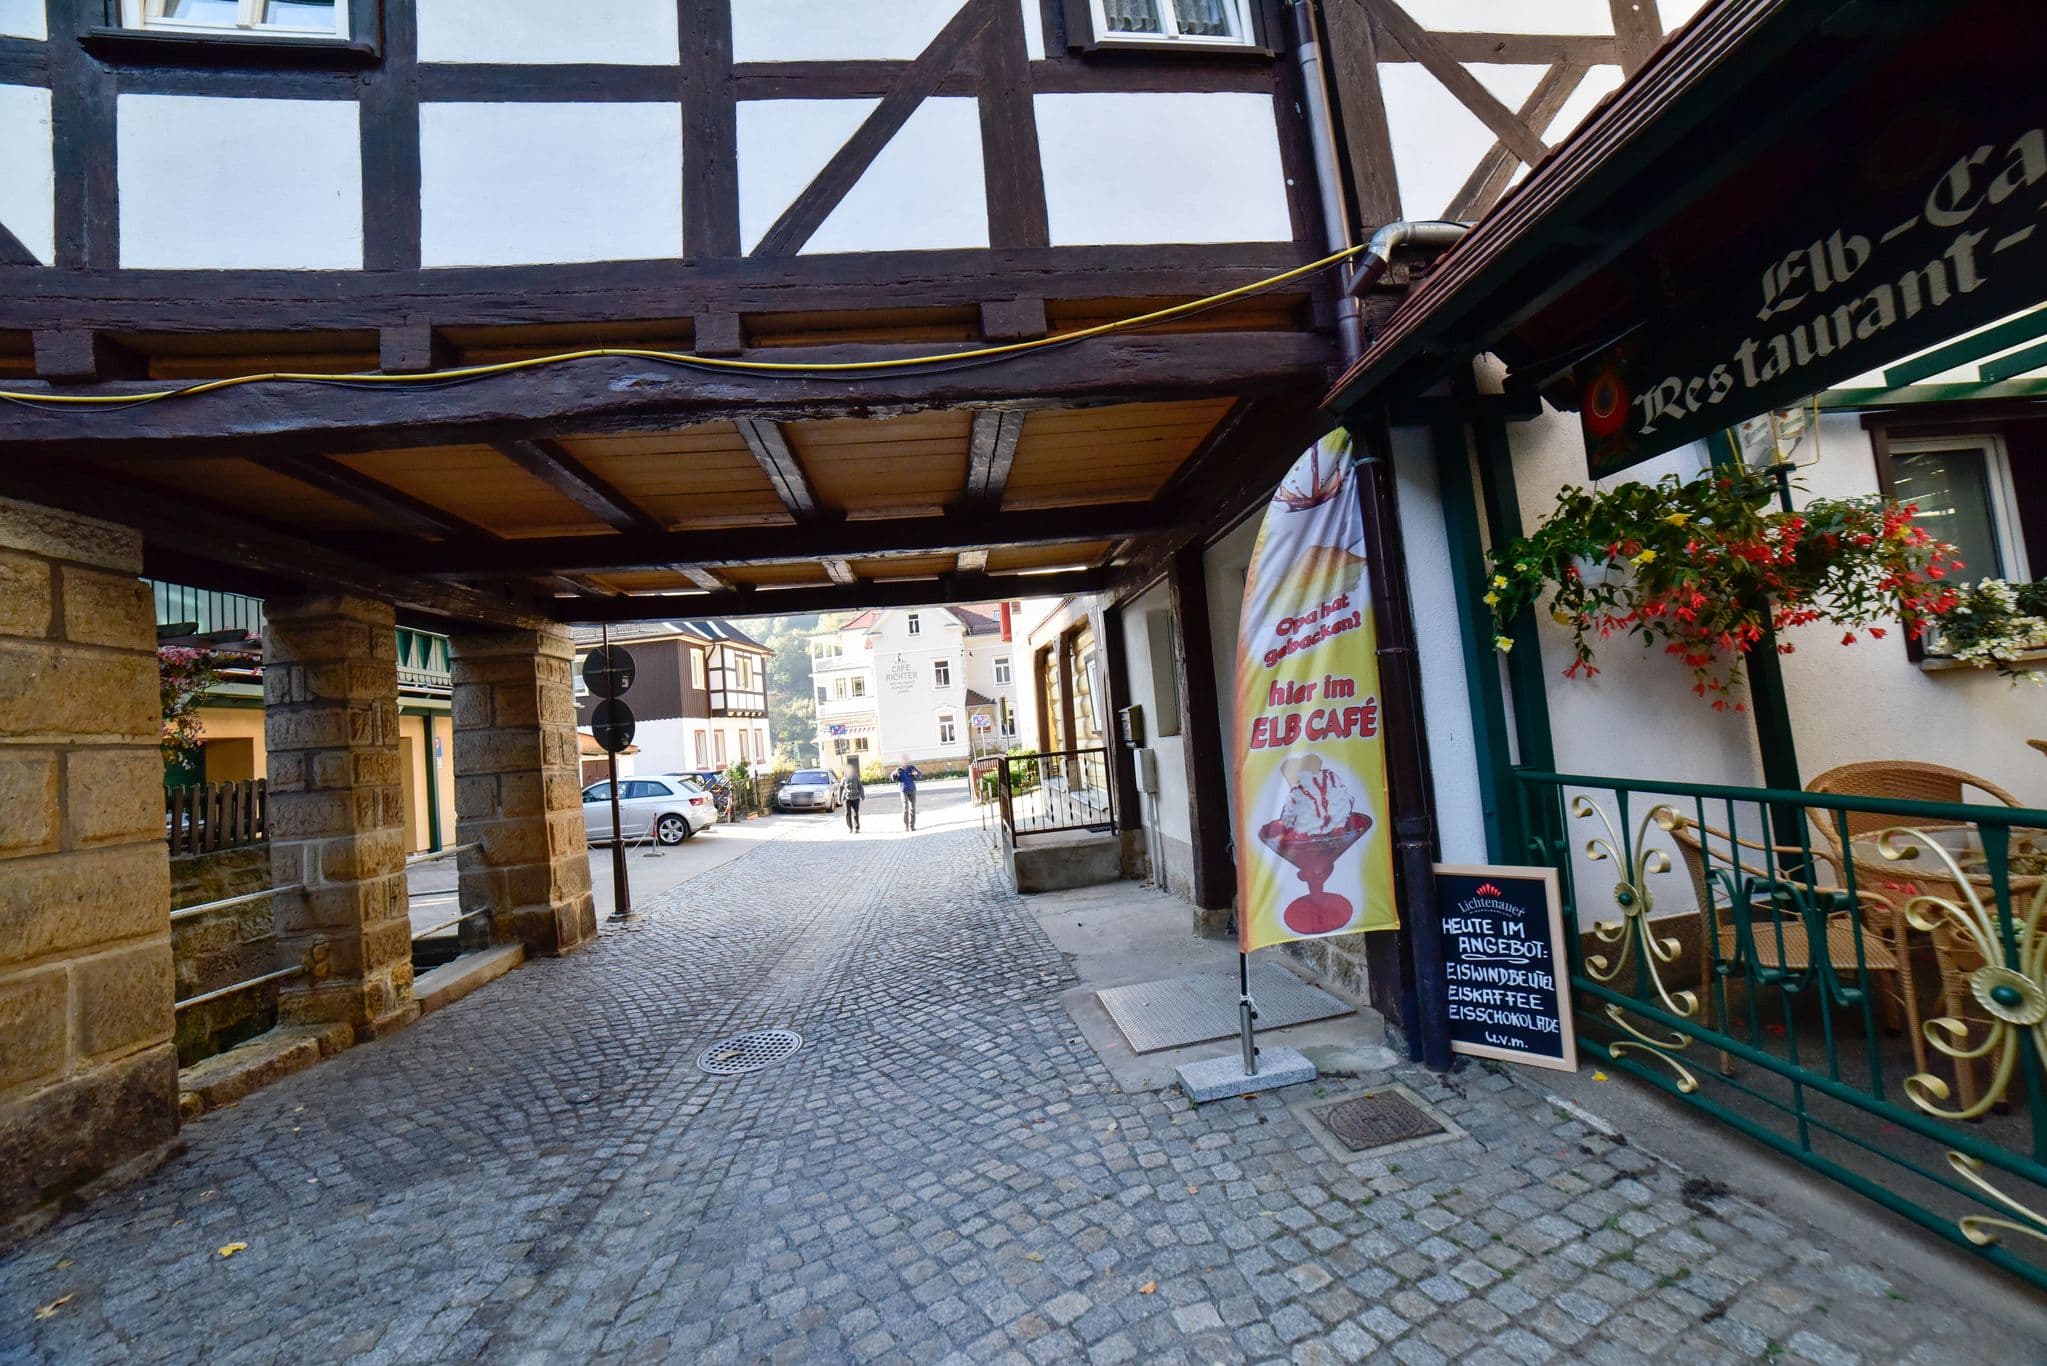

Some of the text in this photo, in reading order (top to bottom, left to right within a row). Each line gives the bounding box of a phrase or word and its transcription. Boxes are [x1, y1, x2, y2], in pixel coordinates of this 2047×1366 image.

[1633, 200, 2047, 435] Restaurant-
[1275, 592, 1350, 637] Opa hat
[1264, 610, 1361, 668] gebacken!
[885, 671, 918, 681] RICHTER
[1268, 674, 1355, 707] hier im
[1250, 697, 1377, 749] ELB CAFÉ
[1458, 897, 1525, 917] Lichtenauer
[1442, 917, 1525, 938] HEUTE IM
[1458, 936, 1549, 959] ANGEBOT:
[1446, 962, 1556, 991] EISWINDBEUTEL
[1447, 986, 1544, 1010] EISKAFFEE
[1448, 1004, 1561, 1033] EISSCHOKOLADE
